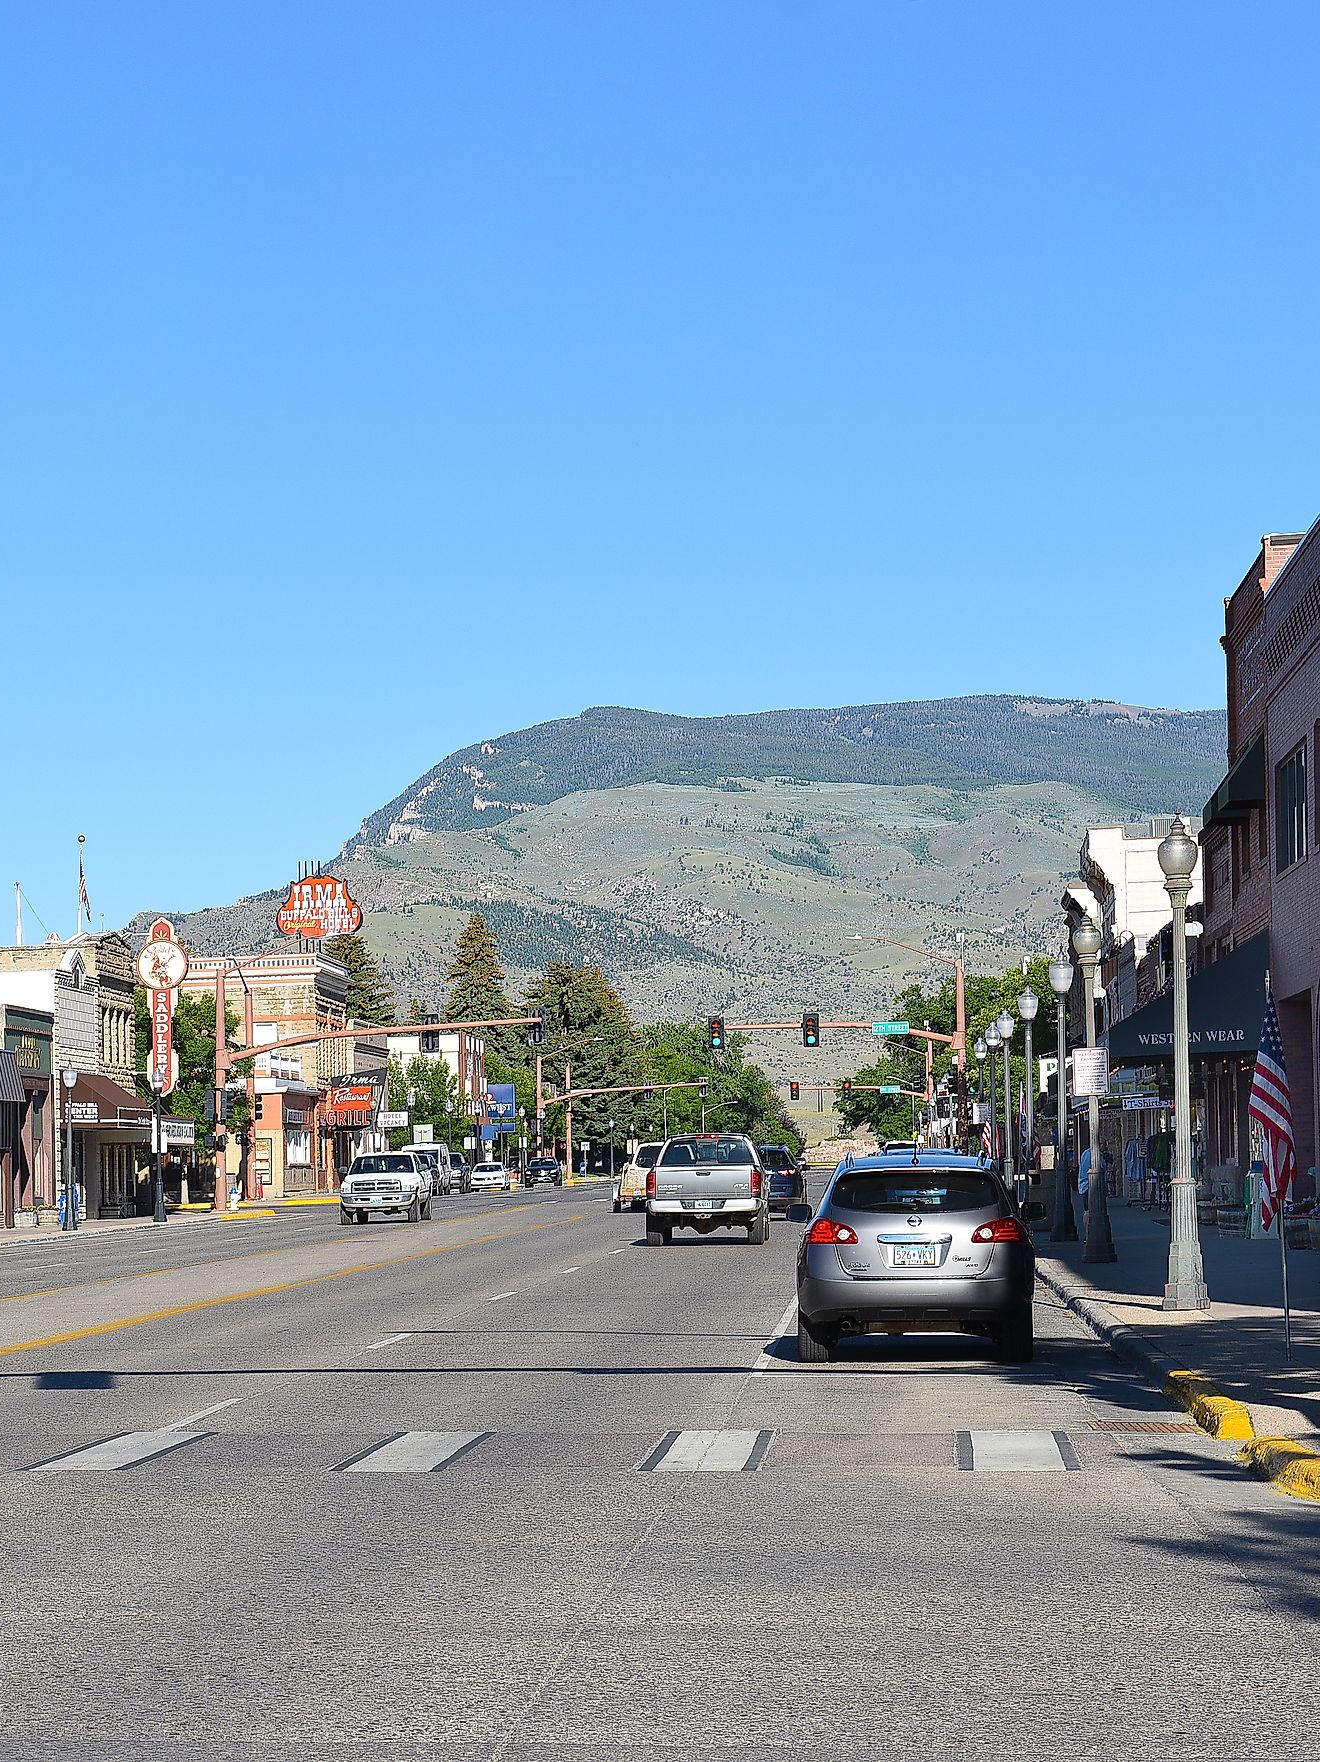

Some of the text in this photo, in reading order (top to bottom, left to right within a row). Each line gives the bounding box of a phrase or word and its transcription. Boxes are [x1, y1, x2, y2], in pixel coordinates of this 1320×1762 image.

[294, 884, 346, 909] IRMA
[281, 908, 326, 920] BUFFALO
[321, 919, 356, 930] HOTEL
[155, 992, 169, 1074] SADDLERY
[1138, 1029, 1245, 1046] WESTRN WEAR
[338, 1074, 380, 1087] Irma
[332, 1087, 372, 1105] Restaurant
[1128, 1100, 1163, 1109] T-Shirts
[327, 1109, 371, 1127] GRILL
[896, 1250, 933, 1260] 526 VKY
